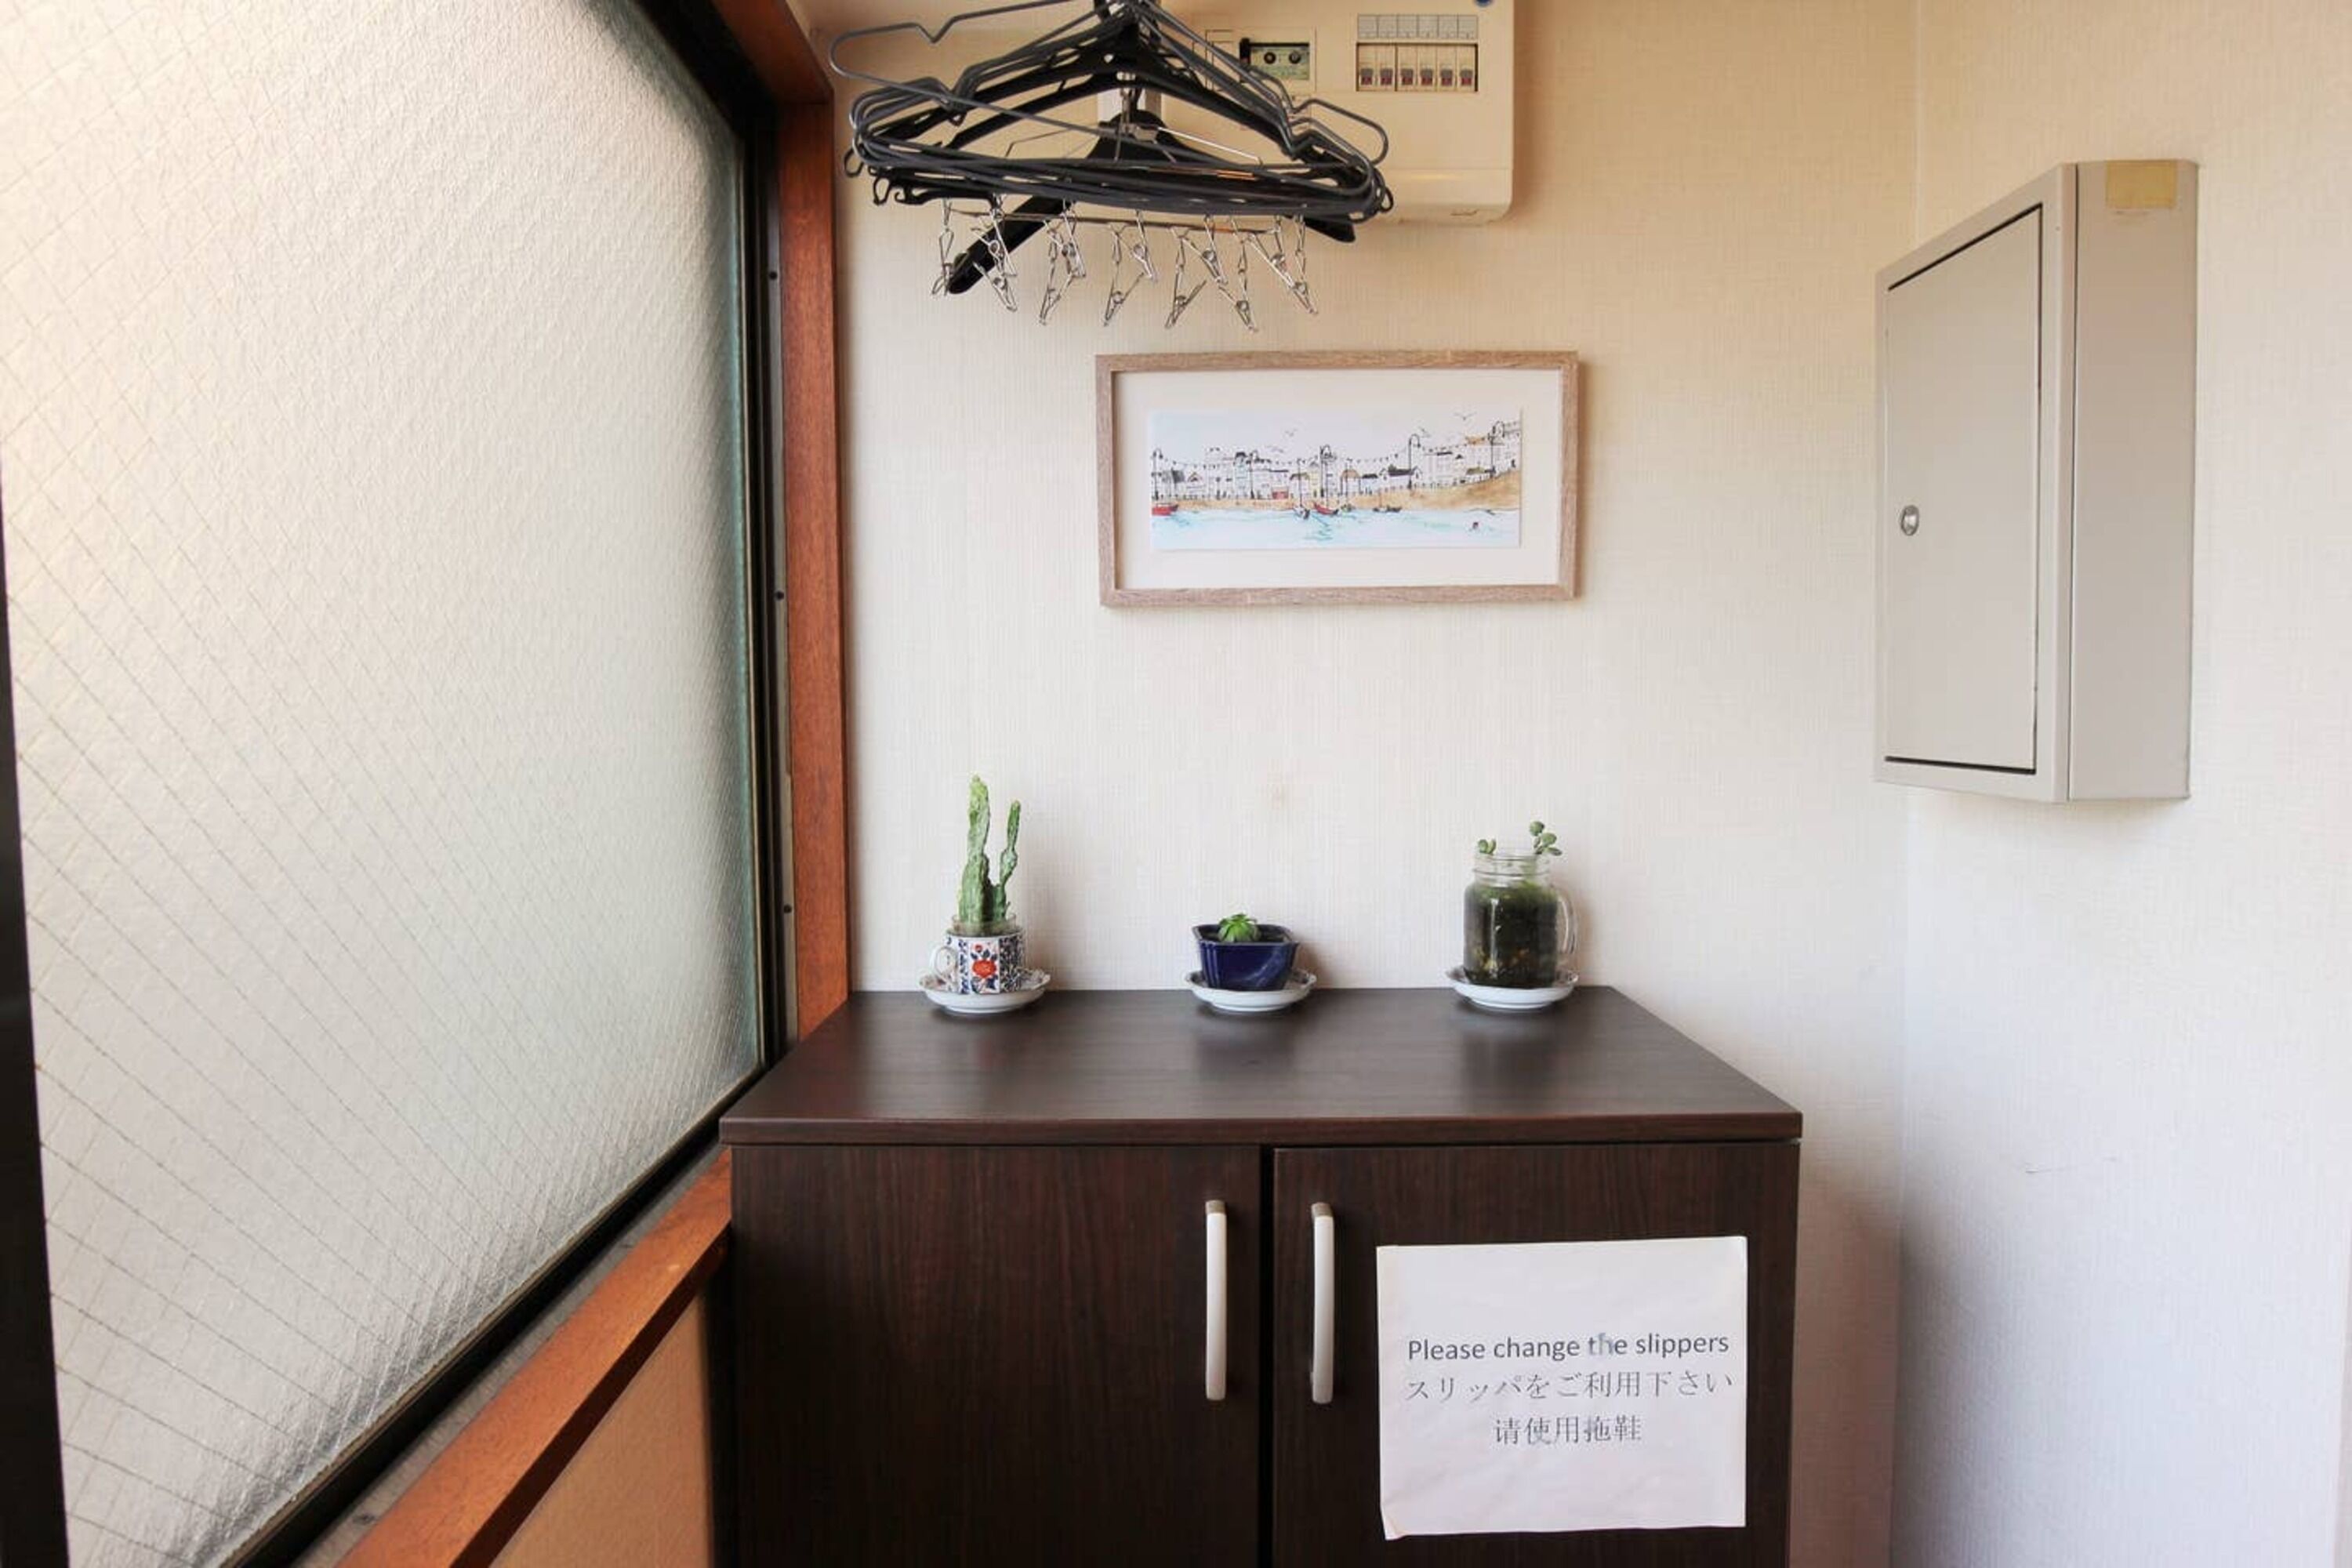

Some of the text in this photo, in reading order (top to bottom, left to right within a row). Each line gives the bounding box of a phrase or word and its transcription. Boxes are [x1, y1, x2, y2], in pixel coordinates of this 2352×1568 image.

[1408, 1332, 1730, 1362] Please change the slippers
[1406, 1370, 1733, 1403] スリッパをご利用下さい
[1494, 1414, 1642, 1445] 请使用拖鞋
